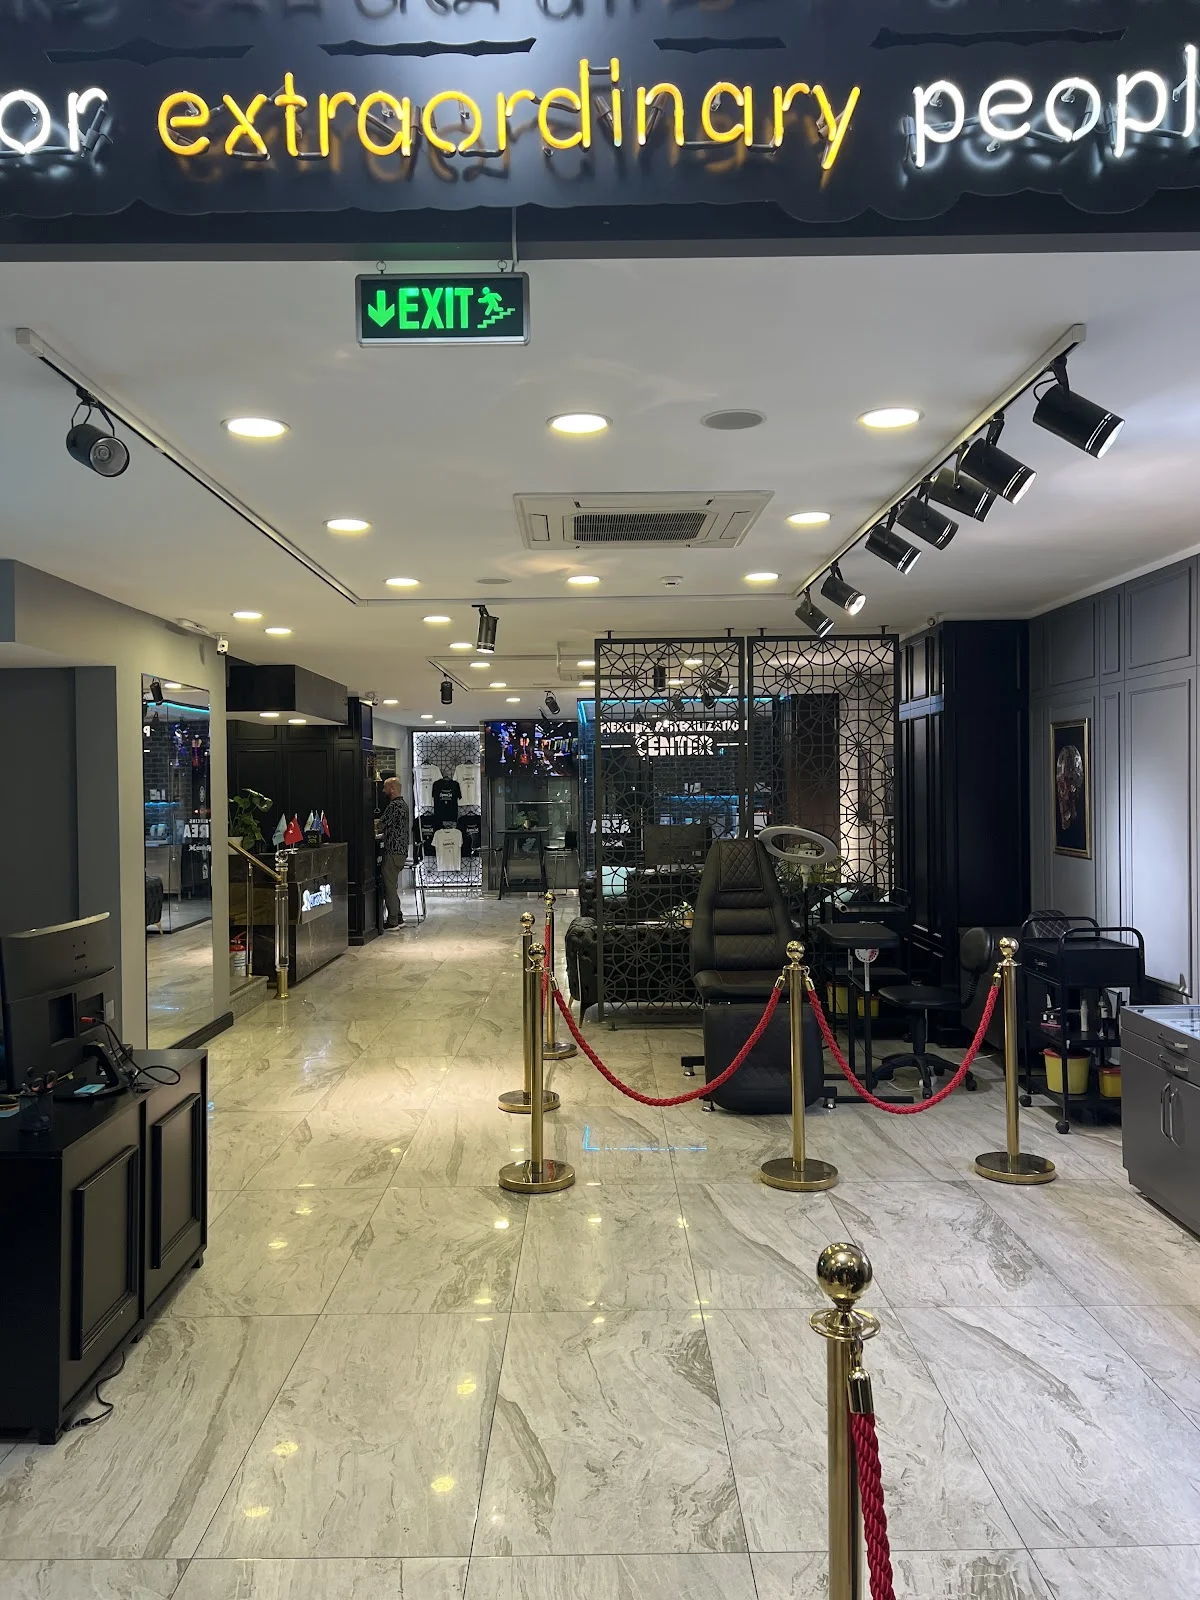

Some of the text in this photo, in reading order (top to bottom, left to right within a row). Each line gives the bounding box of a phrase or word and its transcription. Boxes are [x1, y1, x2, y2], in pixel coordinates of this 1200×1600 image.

[0, 87, 108, 154] or
[157, 57, 861, 170] extraordinary
[398, 287, 474, 330] EXIT
[634, 735, 714, 756] CENTER
